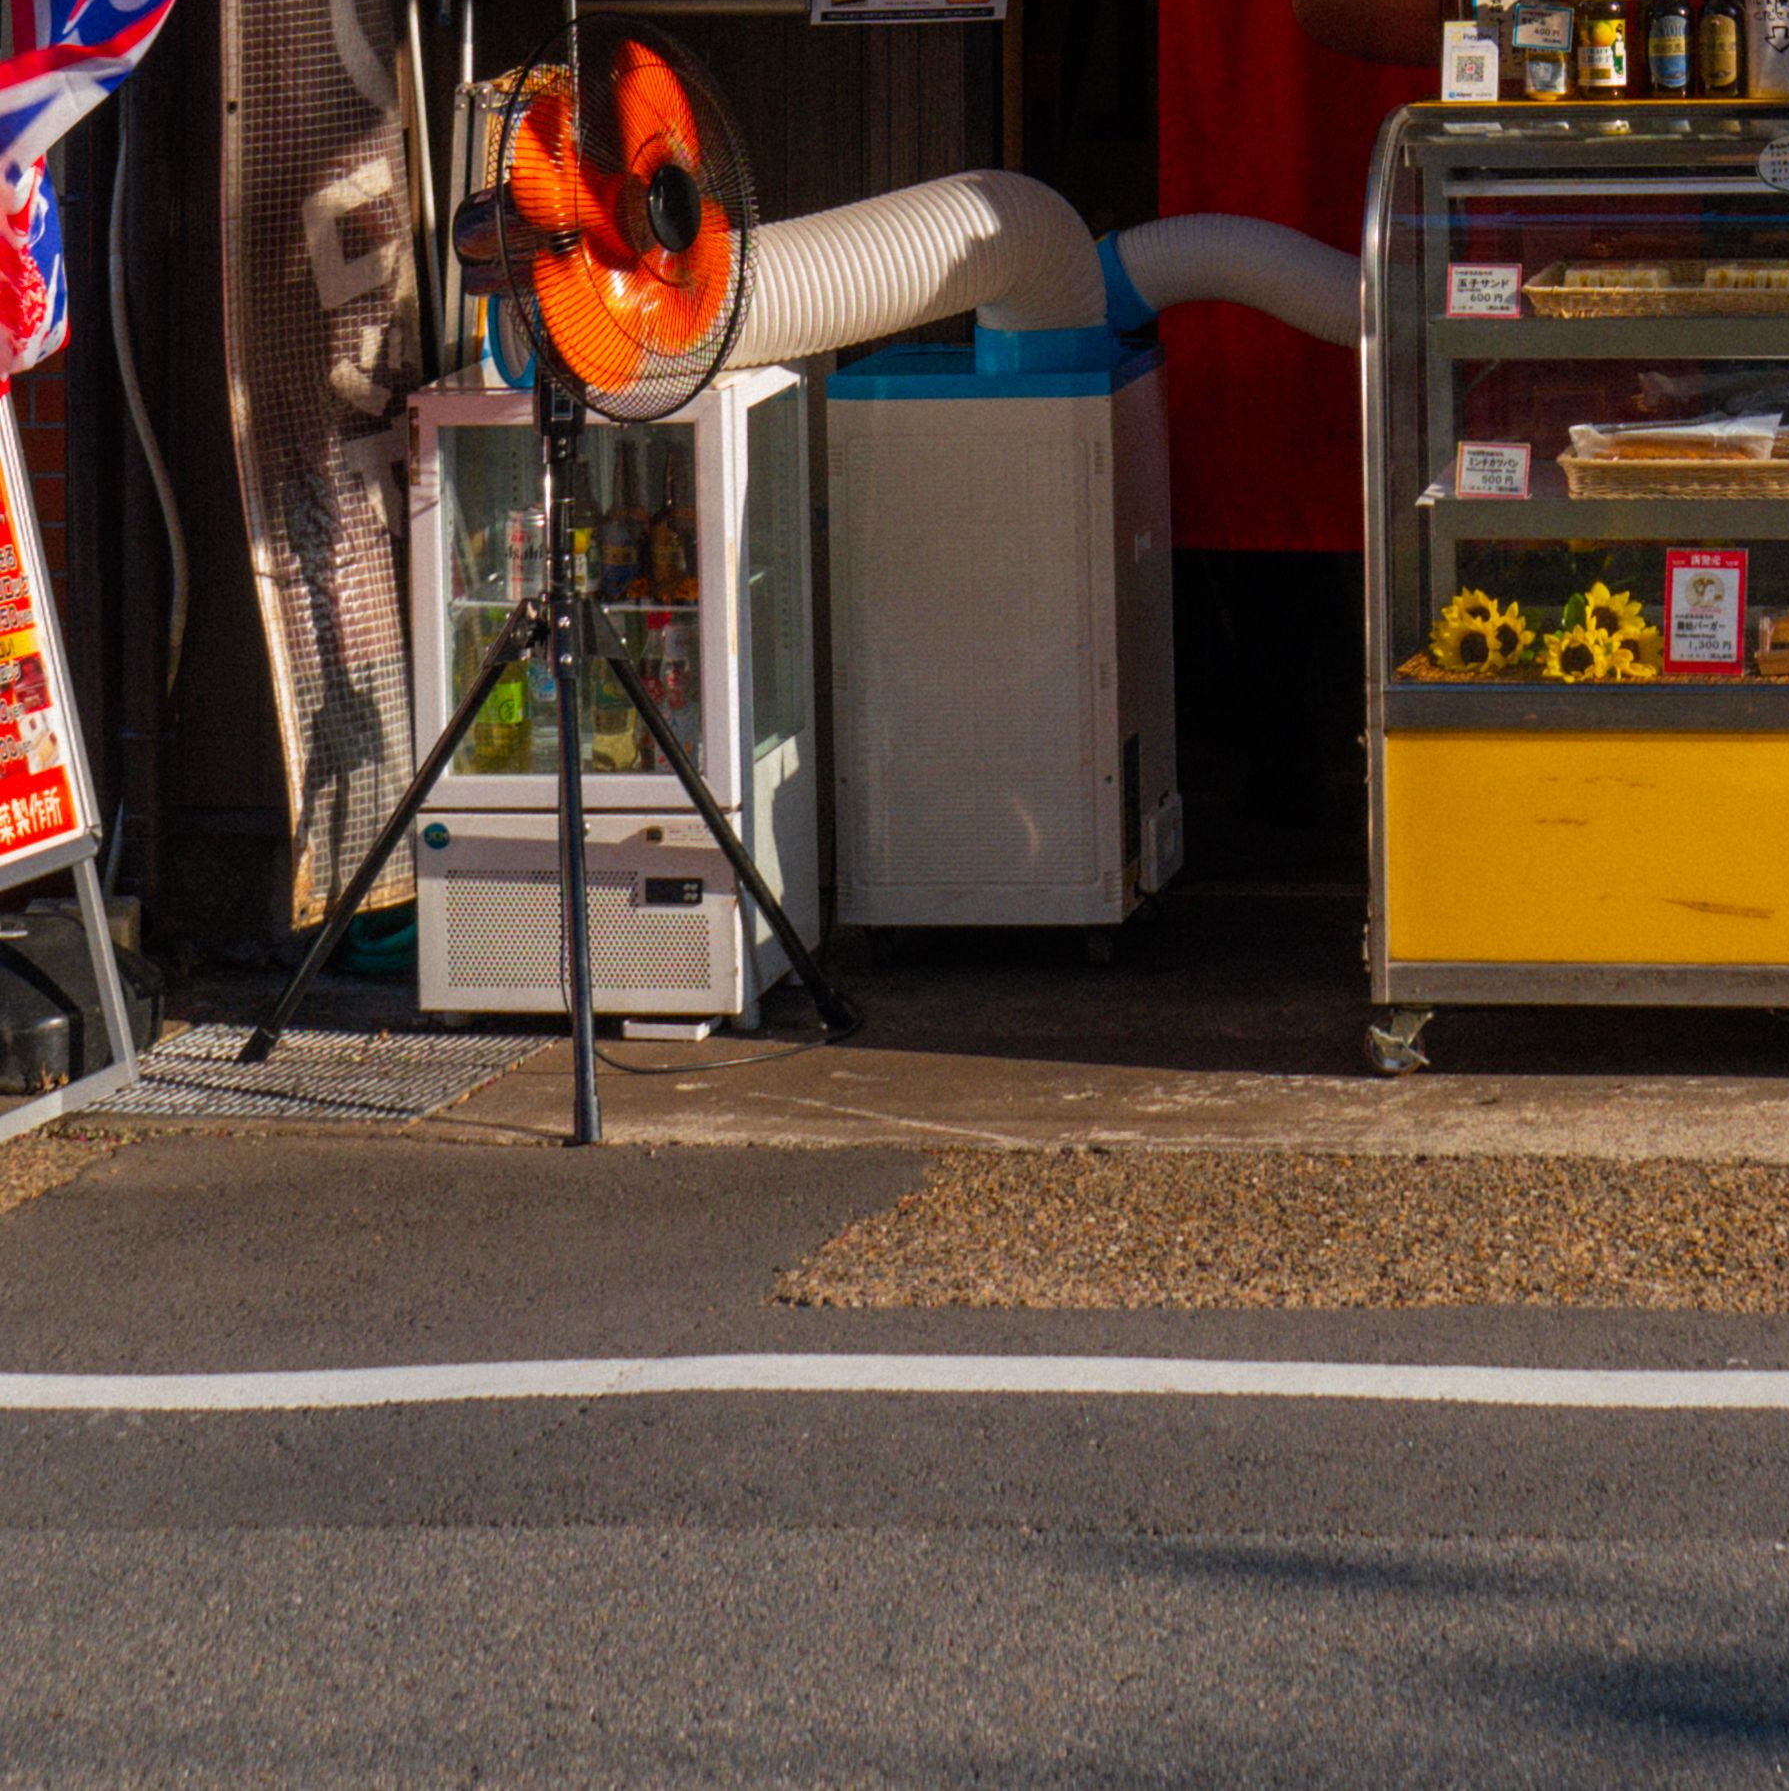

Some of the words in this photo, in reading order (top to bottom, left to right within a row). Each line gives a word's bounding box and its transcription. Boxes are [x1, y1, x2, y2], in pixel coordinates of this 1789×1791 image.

[1457, 278, 1510, 289] 玉子サンド
[1470, 293, 1491, 303] 600
[1481, 475, 1502, 485] 500
